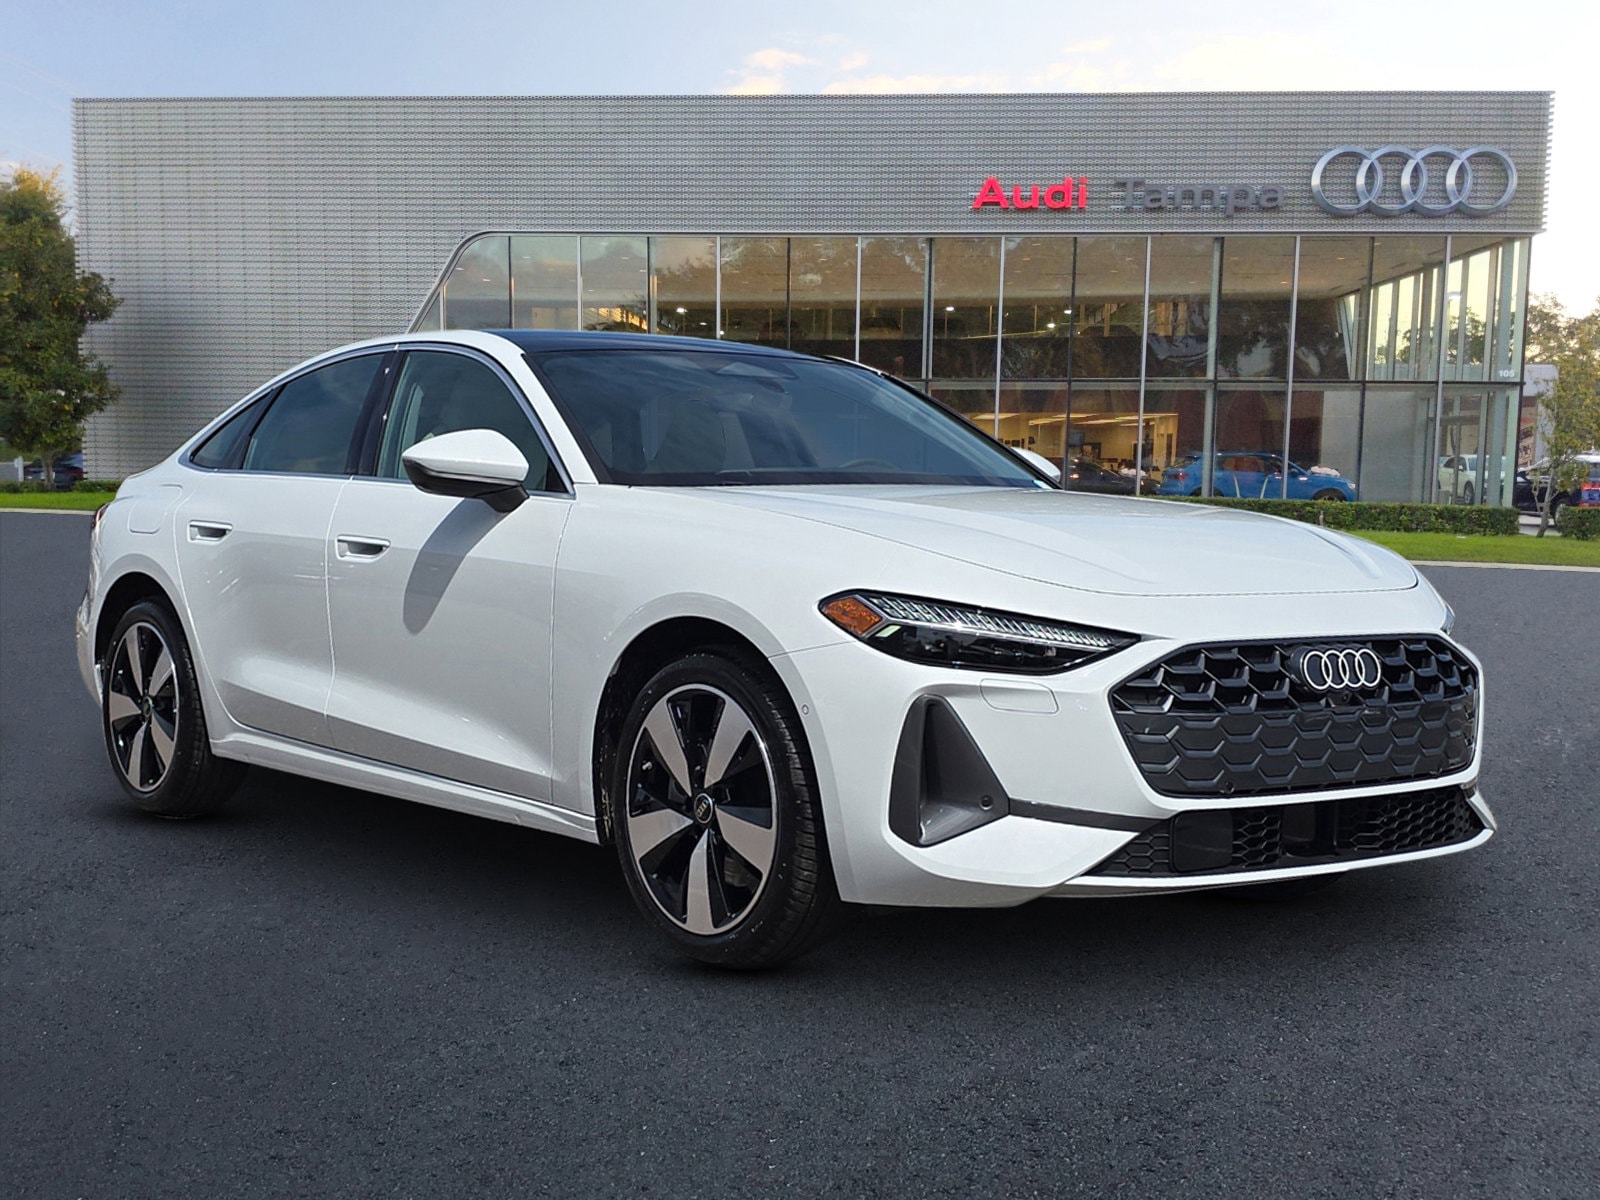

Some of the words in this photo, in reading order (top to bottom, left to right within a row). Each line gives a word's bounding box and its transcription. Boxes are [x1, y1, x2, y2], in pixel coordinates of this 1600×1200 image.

[972, 176, 1088, 210] Audi
[1114, 176, 1281, 217] Tampa
[1498, 369, 1515, 378] 105
